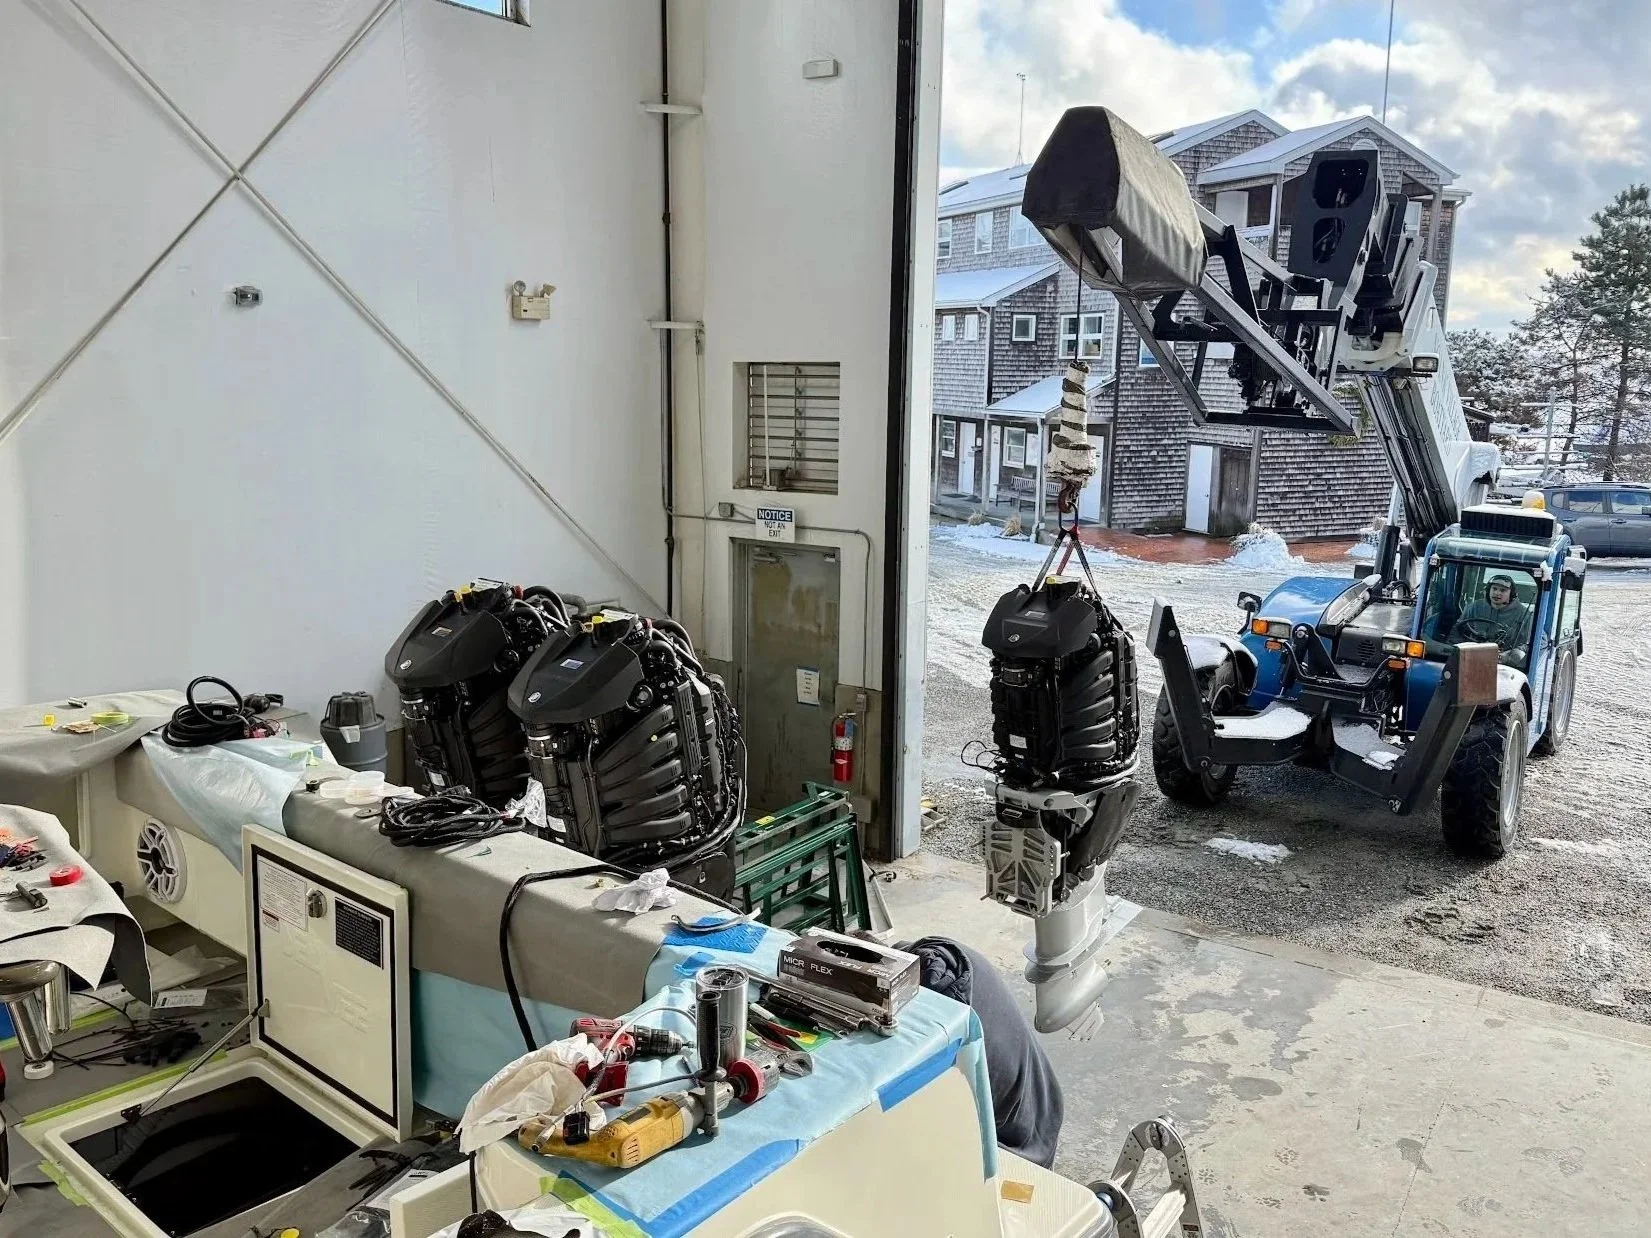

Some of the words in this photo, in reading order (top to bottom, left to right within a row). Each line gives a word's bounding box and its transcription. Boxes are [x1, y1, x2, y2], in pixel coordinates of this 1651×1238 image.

[758, 510, 791, 521] NOTICE
[764, 521, 776, 529] NOT
[777, 522, 786, 530] AN
[810, 963, 833, 976] FLEX
